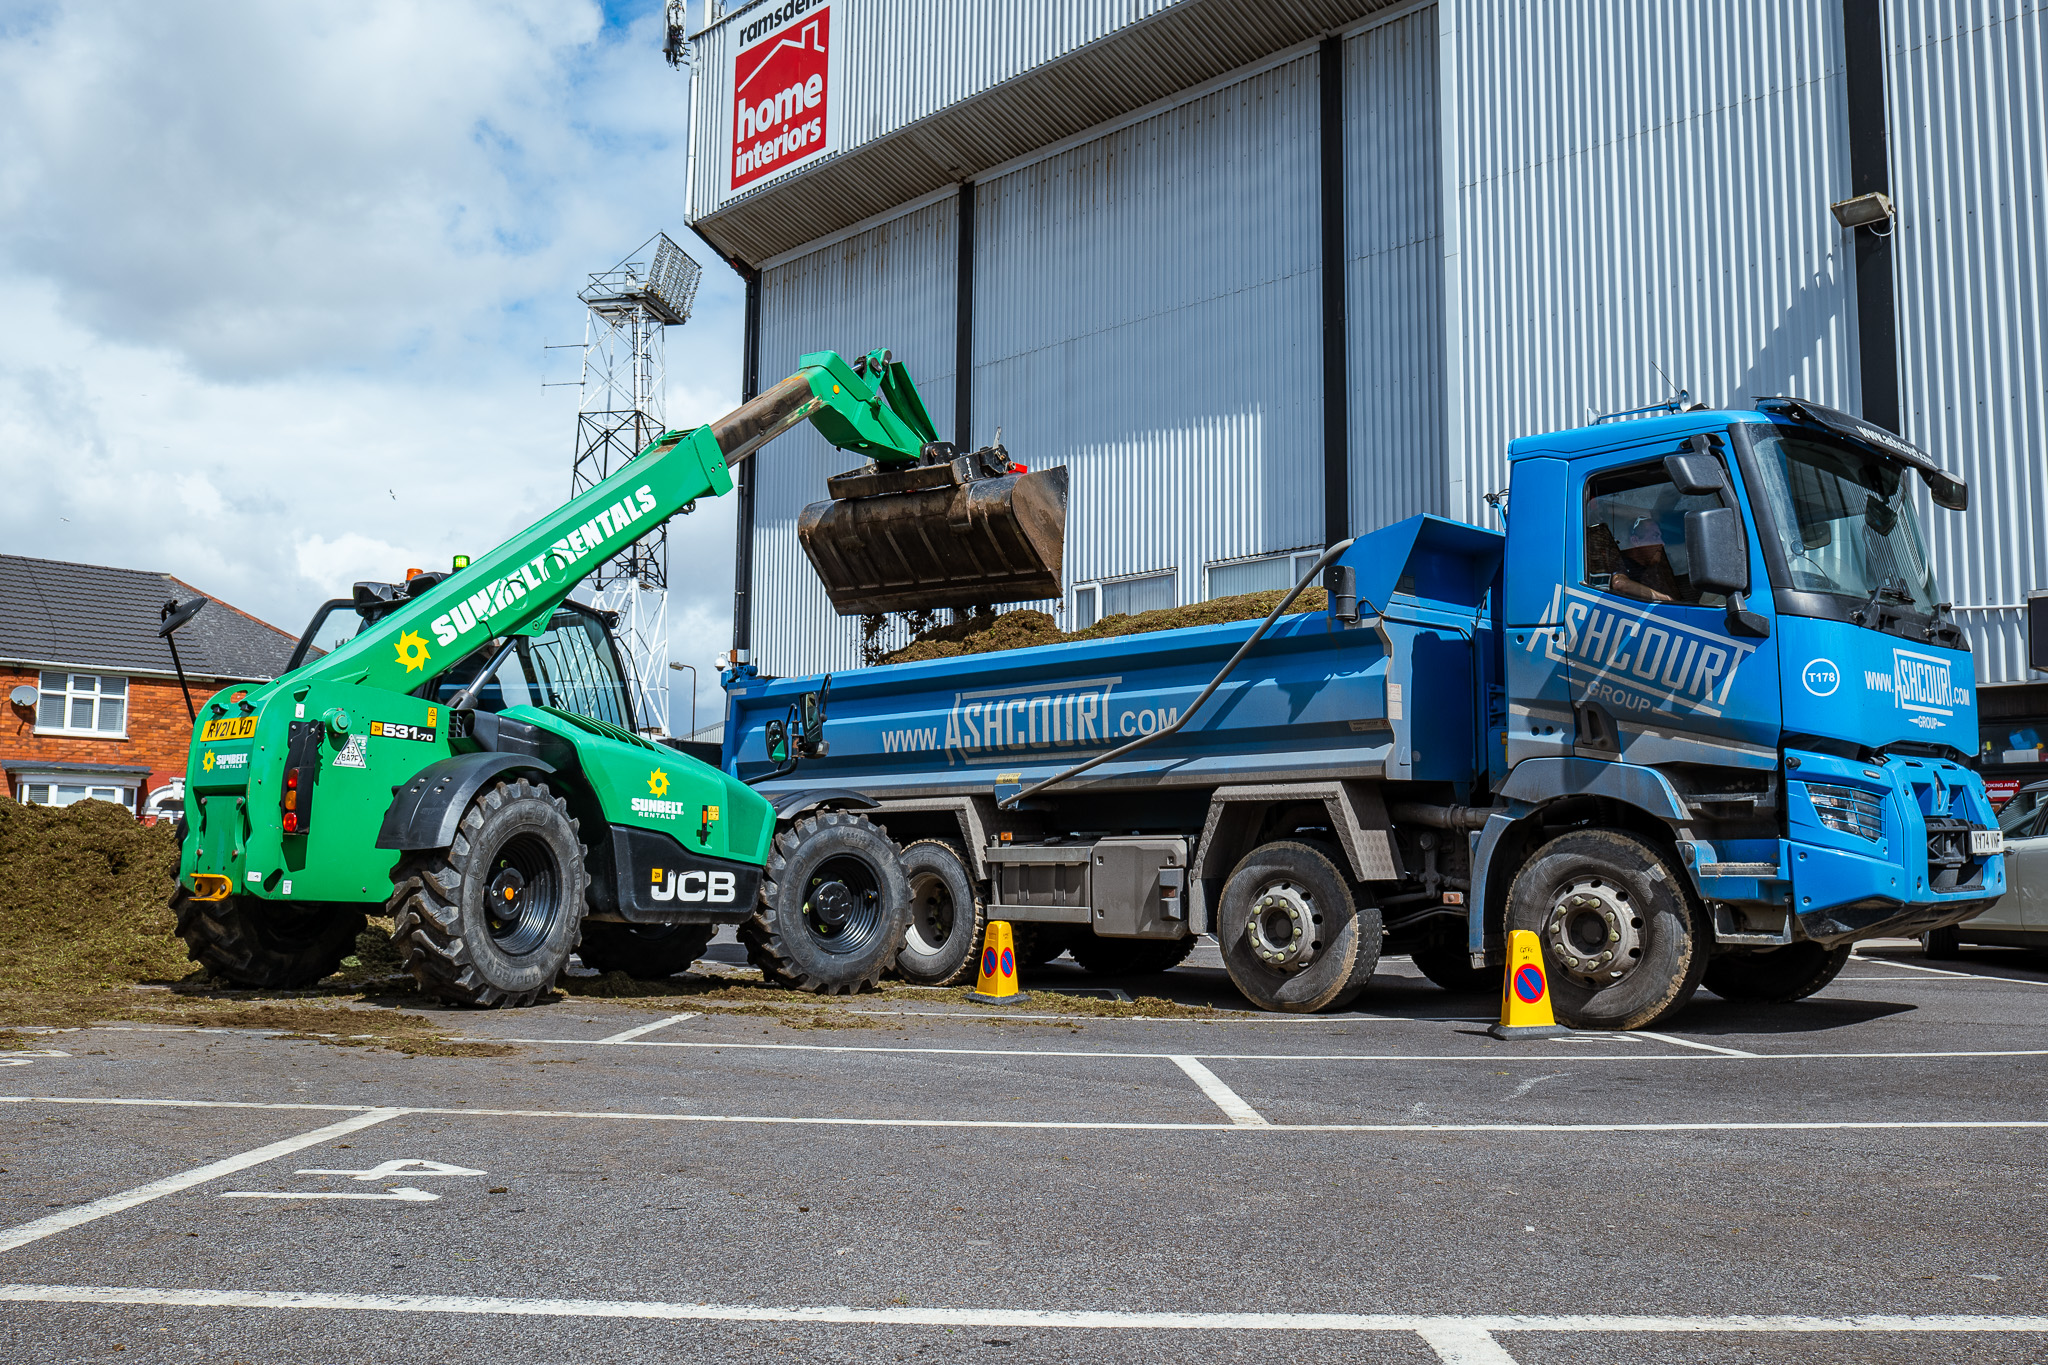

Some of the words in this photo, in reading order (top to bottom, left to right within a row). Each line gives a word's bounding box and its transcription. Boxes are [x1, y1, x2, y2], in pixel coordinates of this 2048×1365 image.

[737, 73, 823, 144] home
[735, 117, 822, 178] interiors
[1526, 583, 1757, 718] ASHCOURT
[1808, 672, 1836, 684] T178
[1586, 680, 1651, 713] GROUP
[1917, 715, 1938, 730] GROUP
[216, 753, 248, 765] SUNBELT
[631, 797, 683, 815] SUNBELT
[638, 811, 676, 820] RENTALS
[651, 869, 736, 903] JCB
